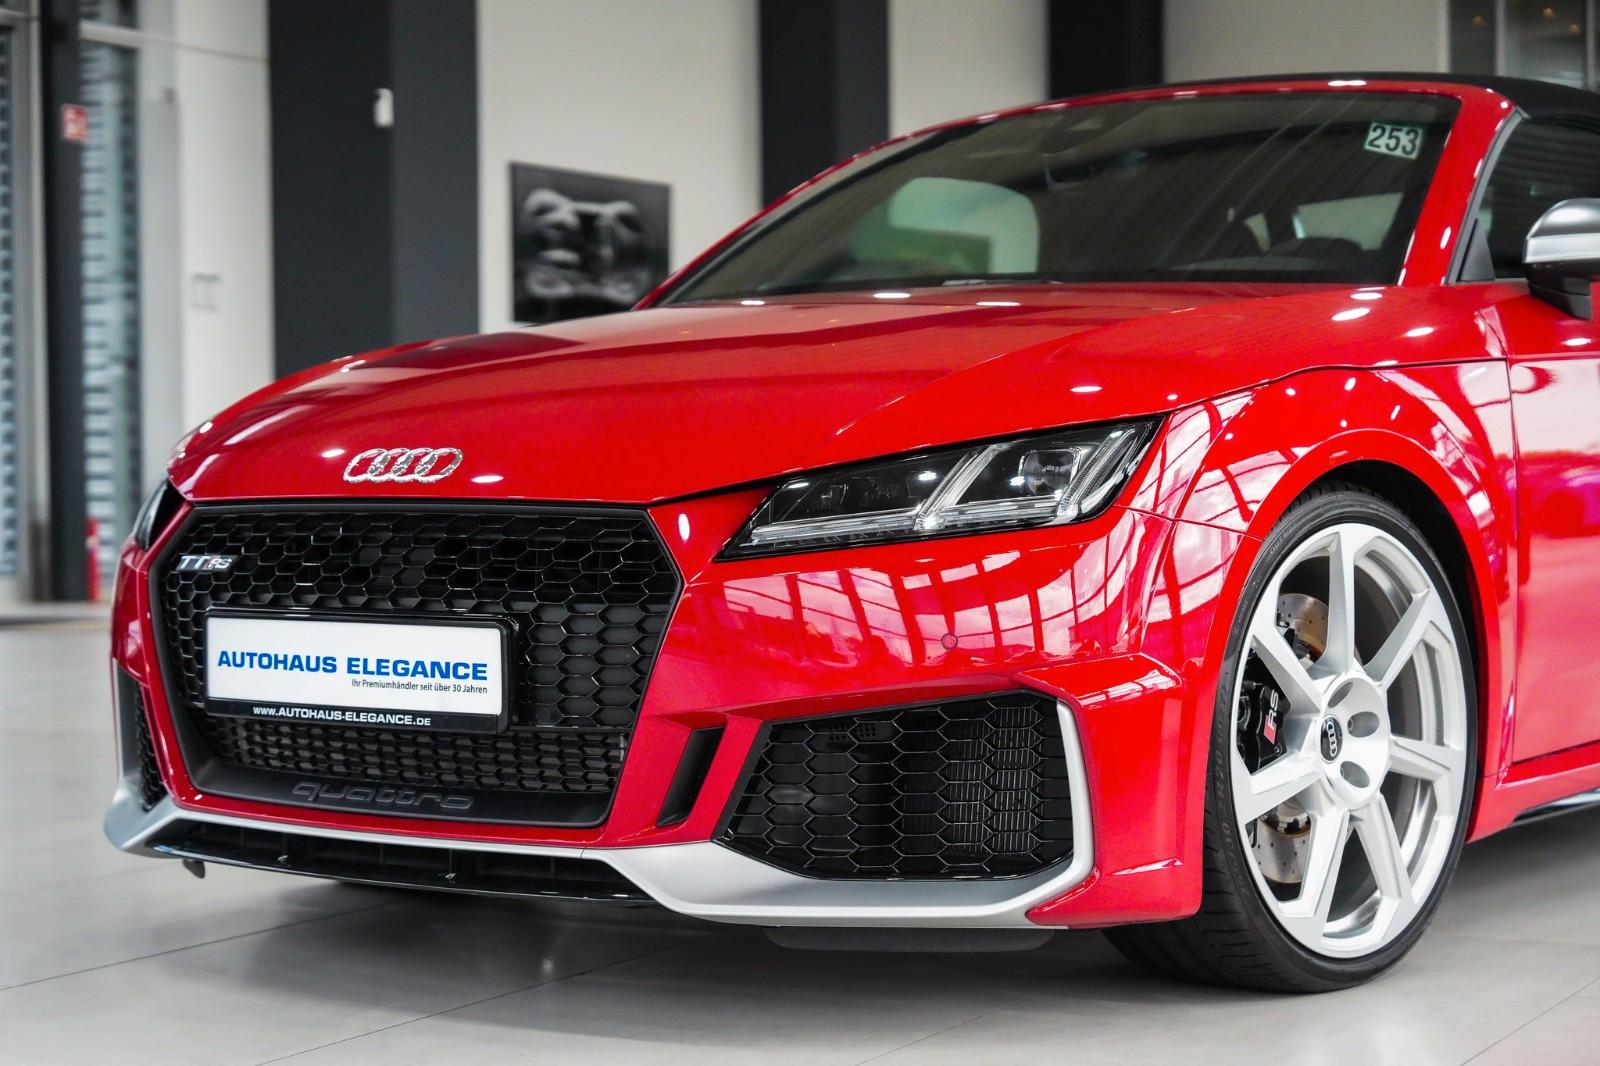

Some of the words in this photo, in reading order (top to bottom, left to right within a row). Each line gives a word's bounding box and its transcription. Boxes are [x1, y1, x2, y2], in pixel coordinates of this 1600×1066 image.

[1367, 124, 1419, 156] 253
[217, 650, 338, 674] AUTOHAUS
[346, 657, 488, 681] ELEGANCE
[351, 678, 361, 688] Ihr
[362, 679, 419, 691] Premiumhändler
[420, 682, 433, 692] seit
[434, 683, 451, 693] über
[452, 684, 462, 693] 30
[463, 684, 488, 694] Jahren
[1267, 689, 1279, 731] RS
[291, 781, 474, 810] quattro
